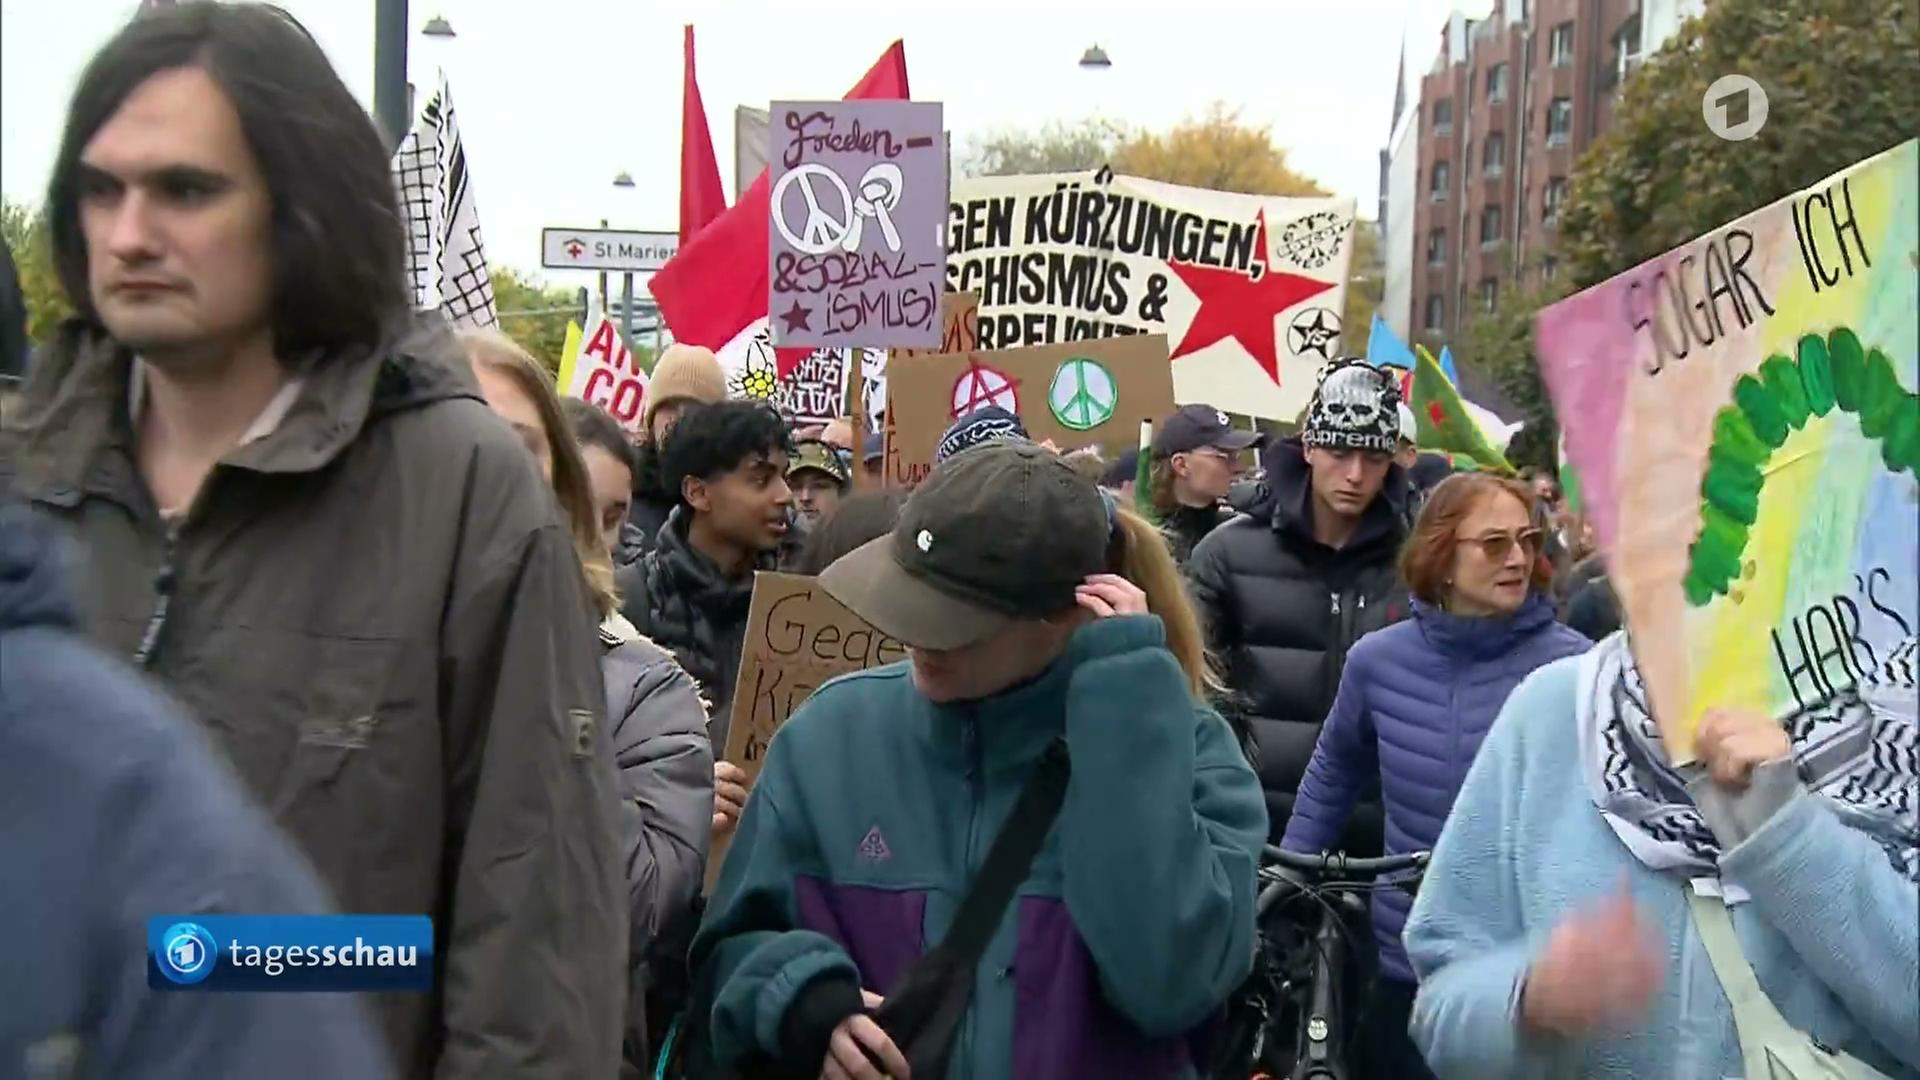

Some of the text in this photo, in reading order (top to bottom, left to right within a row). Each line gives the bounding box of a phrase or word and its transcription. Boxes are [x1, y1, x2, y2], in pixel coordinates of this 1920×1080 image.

[1023, 182, 1265, 281] KÜRZUNGEN,
[1628, 177, 1871, 376] SOGAR ICH
[1138, 273, 1169, 322] &
[1770, 567, 1913, 711] HAB'S
